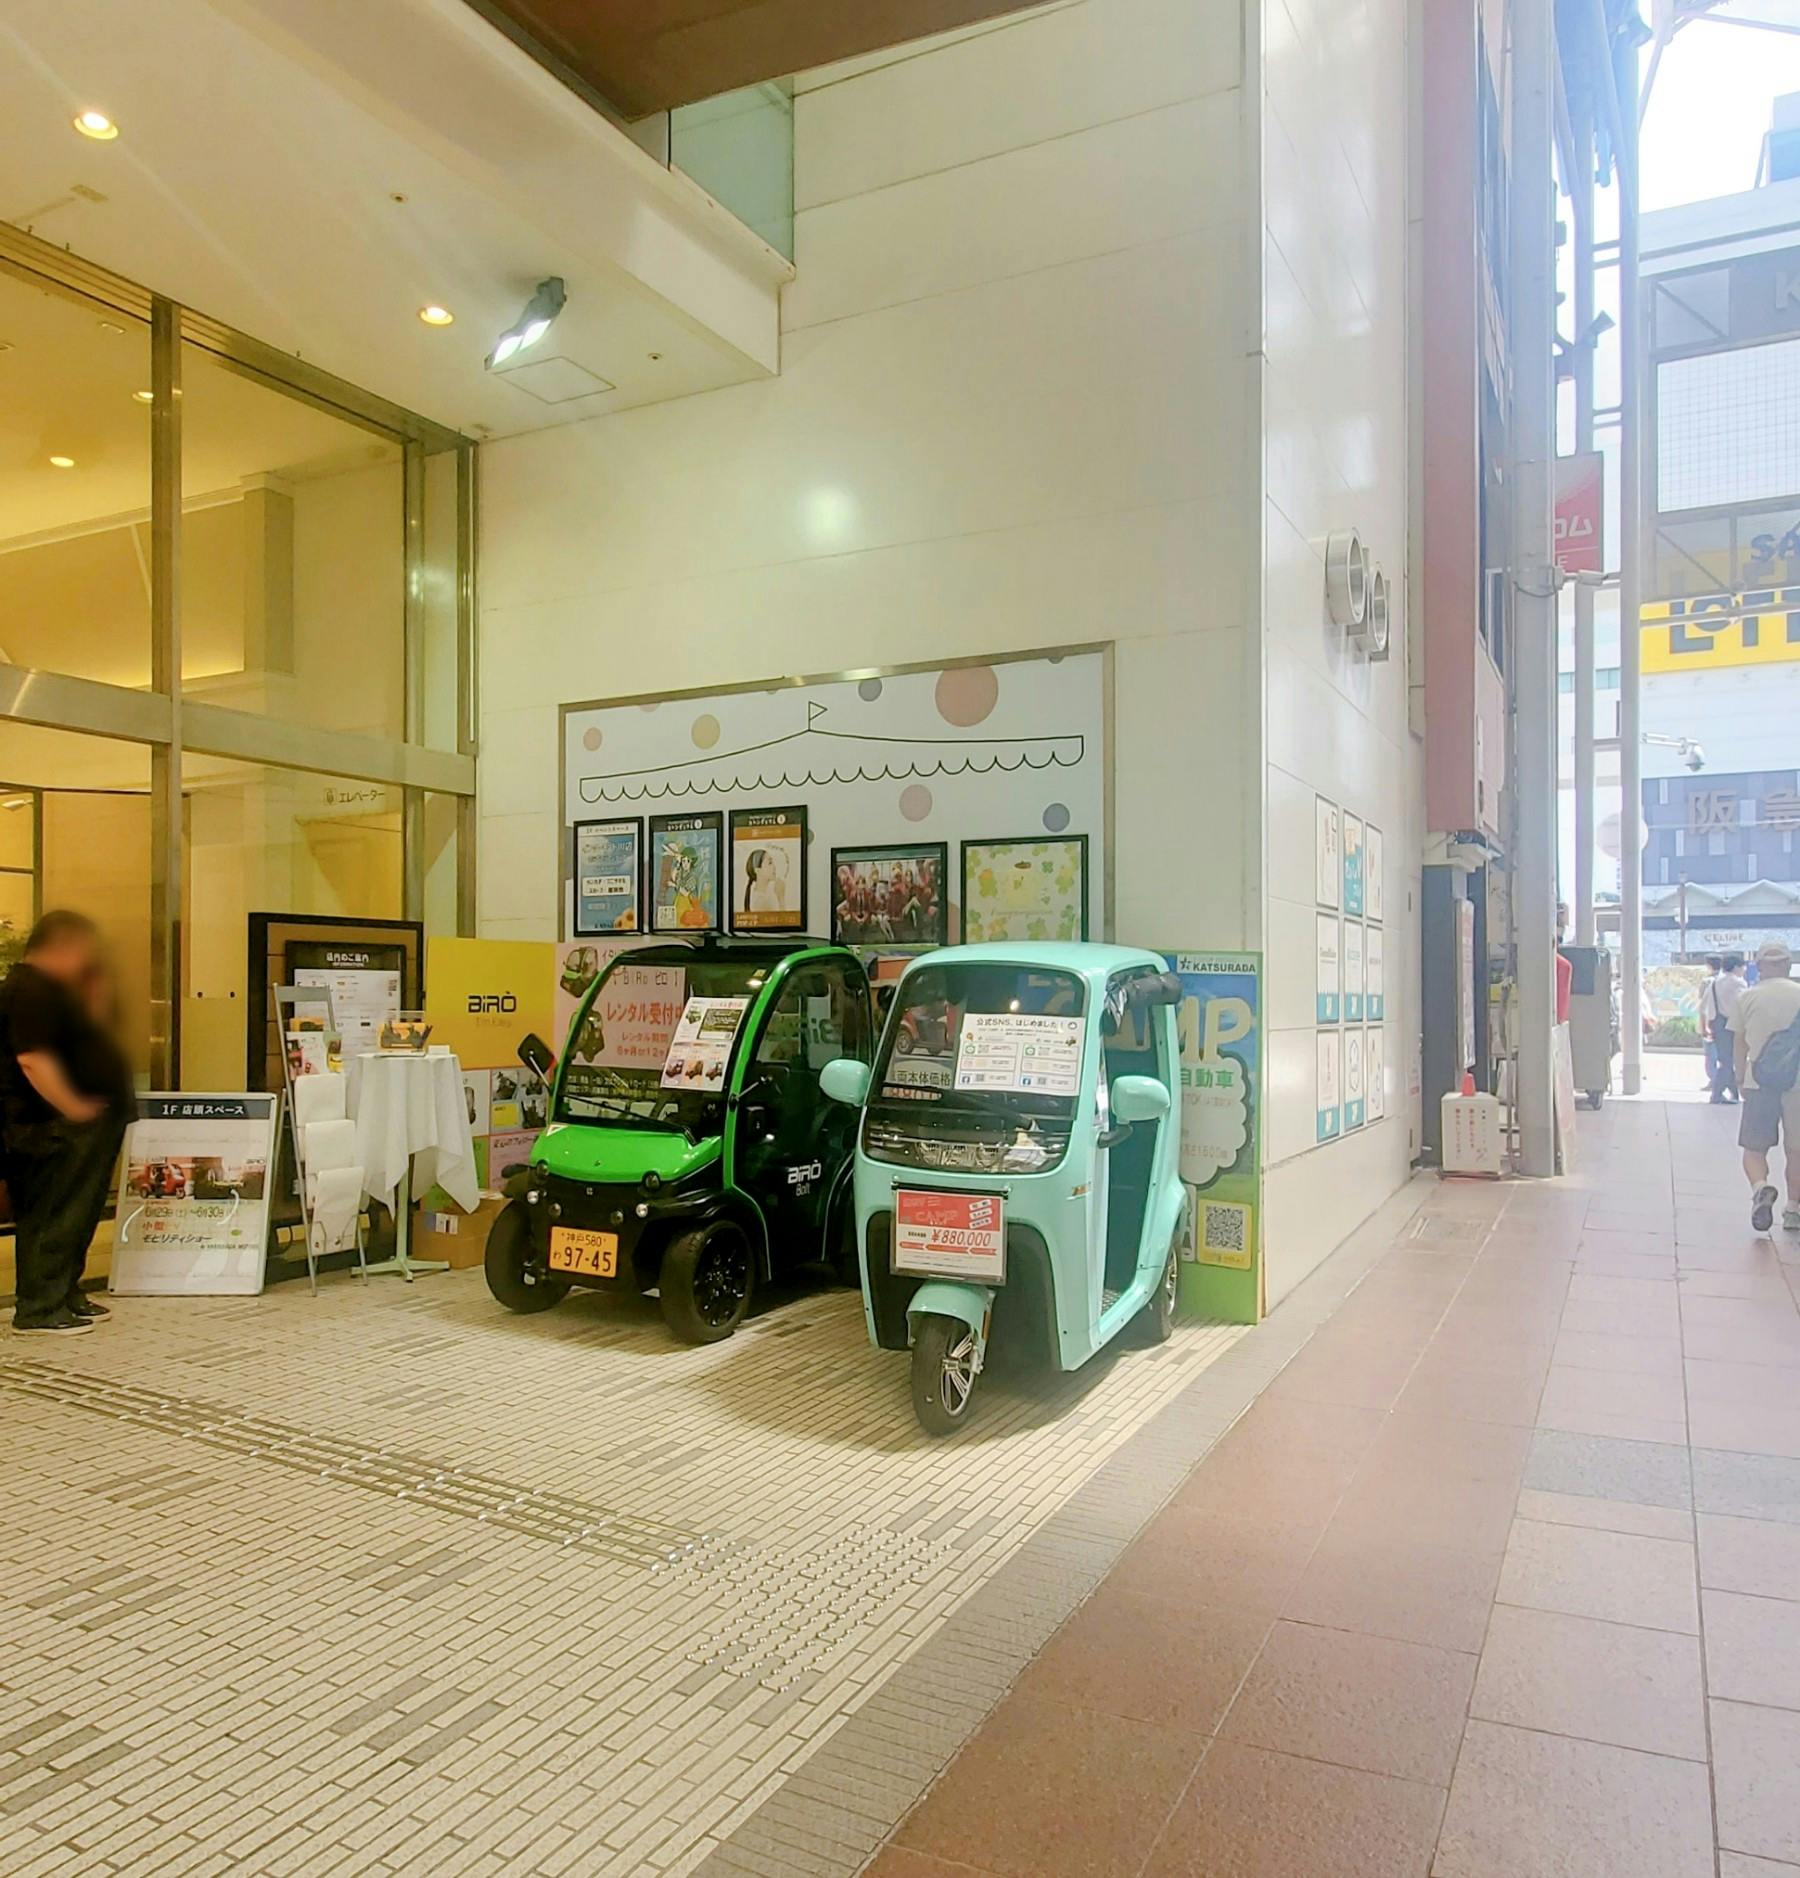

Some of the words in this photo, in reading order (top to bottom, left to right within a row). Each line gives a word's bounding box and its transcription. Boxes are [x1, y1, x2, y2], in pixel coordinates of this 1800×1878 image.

[338, 789, 385, 803] エレベーター
[1688, 788, 1800, 834] 阪急
[1704, 933, 1744, 942] CELINE
[1193, 963, 1255, 972] KATSURADA
[162, 1105, 177, 1115] 1F
[182, 1104, 244, 1115] 店頭スペース
[564, 1246, 612, 1272] 97-45
